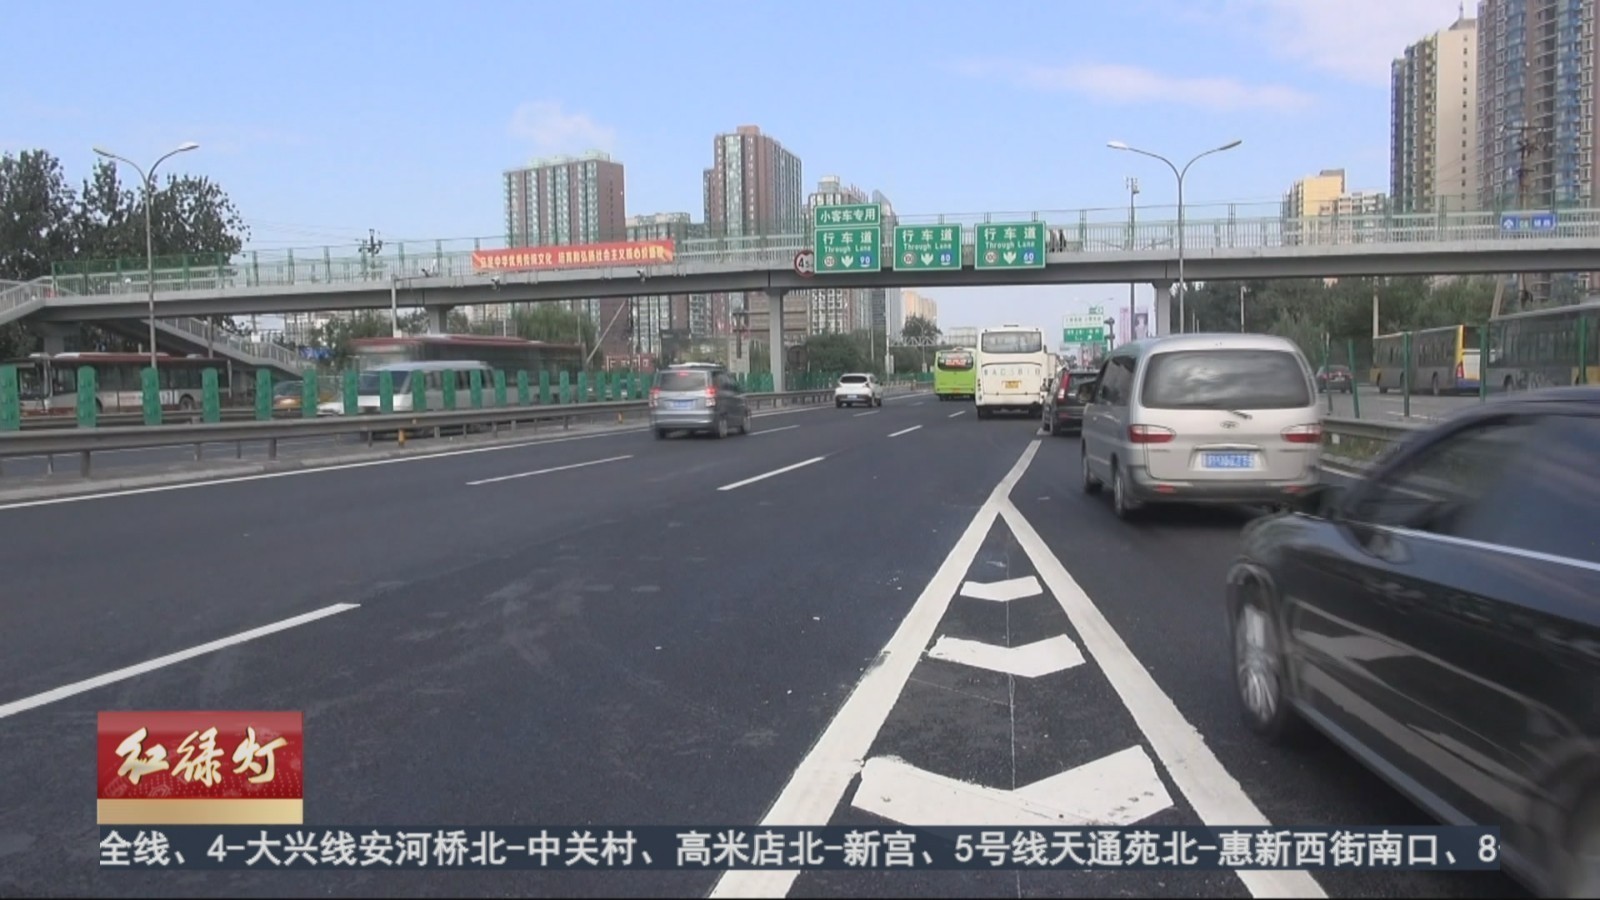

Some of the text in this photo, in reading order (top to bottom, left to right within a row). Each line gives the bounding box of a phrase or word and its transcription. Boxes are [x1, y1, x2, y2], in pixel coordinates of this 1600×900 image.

[820, 208, 876, 223] 小客车专用
[823, 231, 872, 245] 行车道
[902, 228, 953, 242] 行车道
[984, 226, 1036, 241] 行车道
[825, 244, 871, 254] Through Lane
[904, 242, 951, 252] Through Lane
[985, 240, 1035, 250] Through Lane
[860, 255, 871, 264] 90
[1023, 252, 1035, 261] 60
